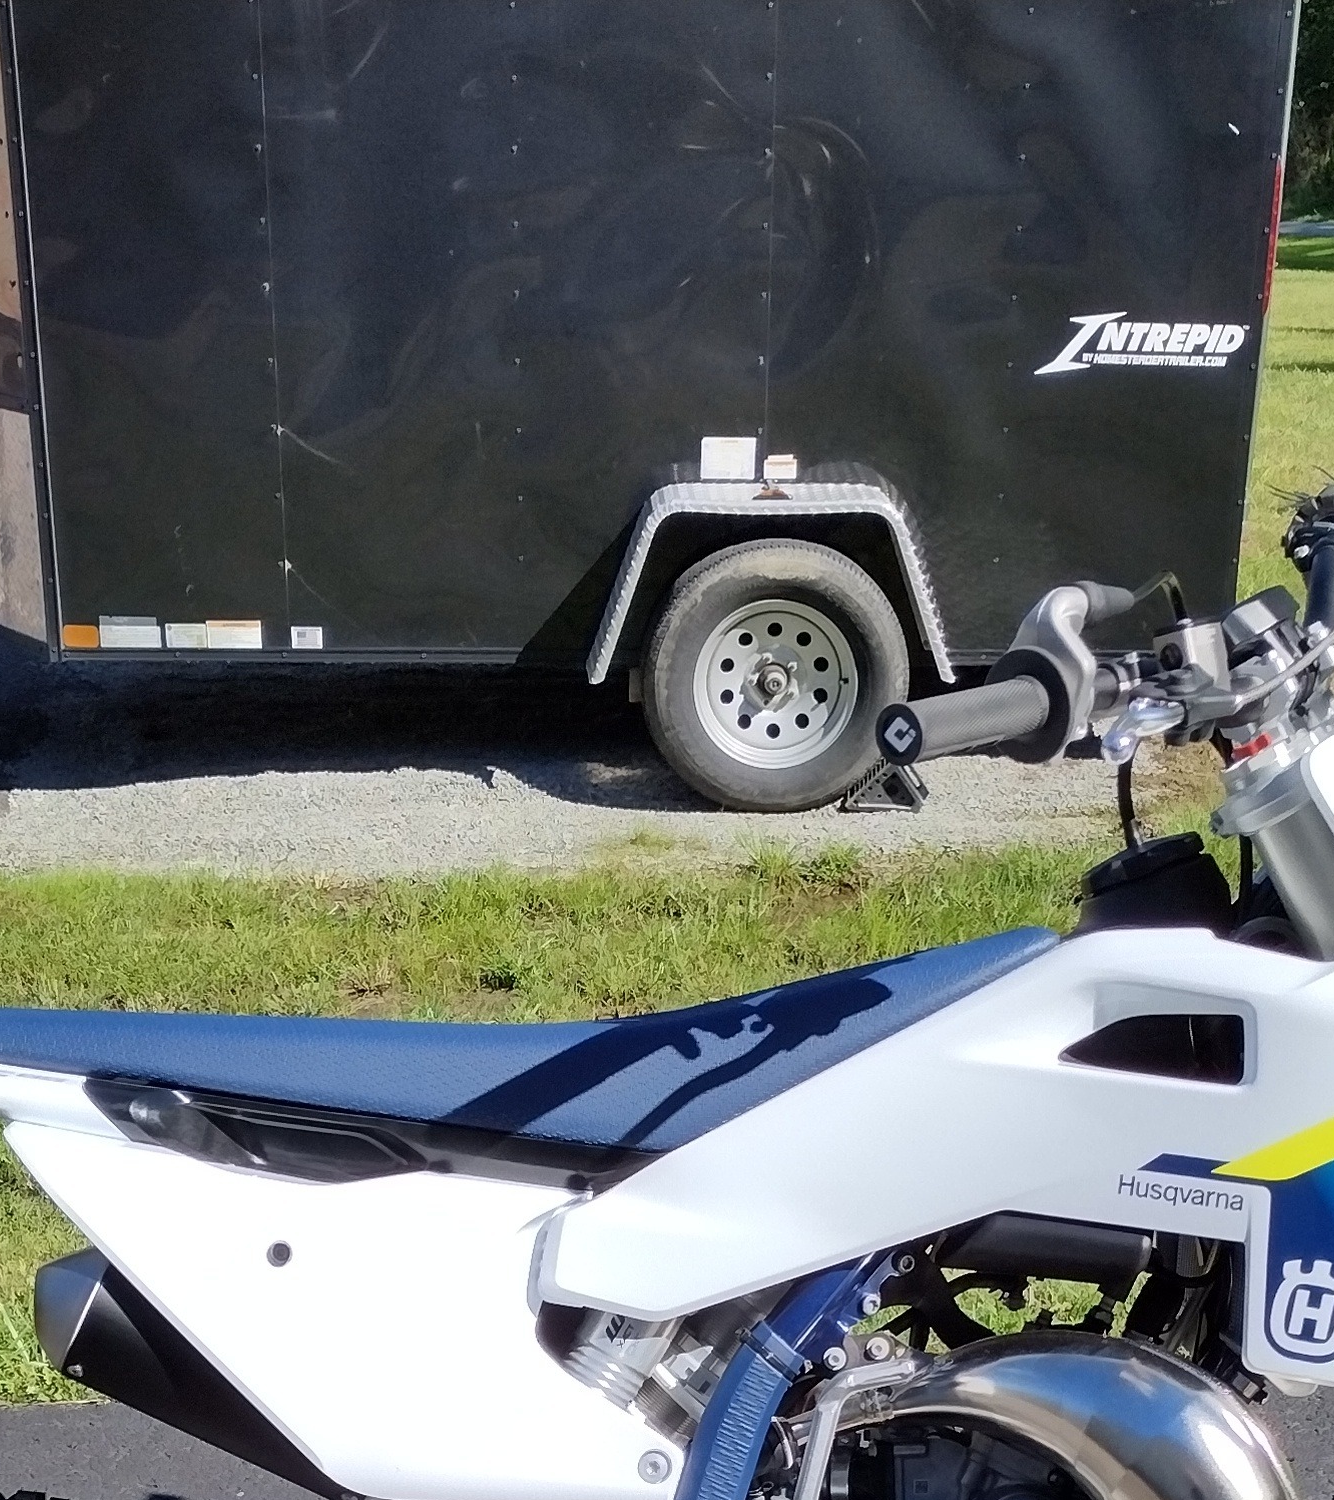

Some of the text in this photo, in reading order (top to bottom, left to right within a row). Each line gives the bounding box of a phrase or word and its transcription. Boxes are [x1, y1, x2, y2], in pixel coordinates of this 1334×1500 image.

[1034, 311, 1245, 375] INTREPID
[1082, 353, 1094, 362] BY
[1118, 1174, 1245, 1211] Husqvarna
